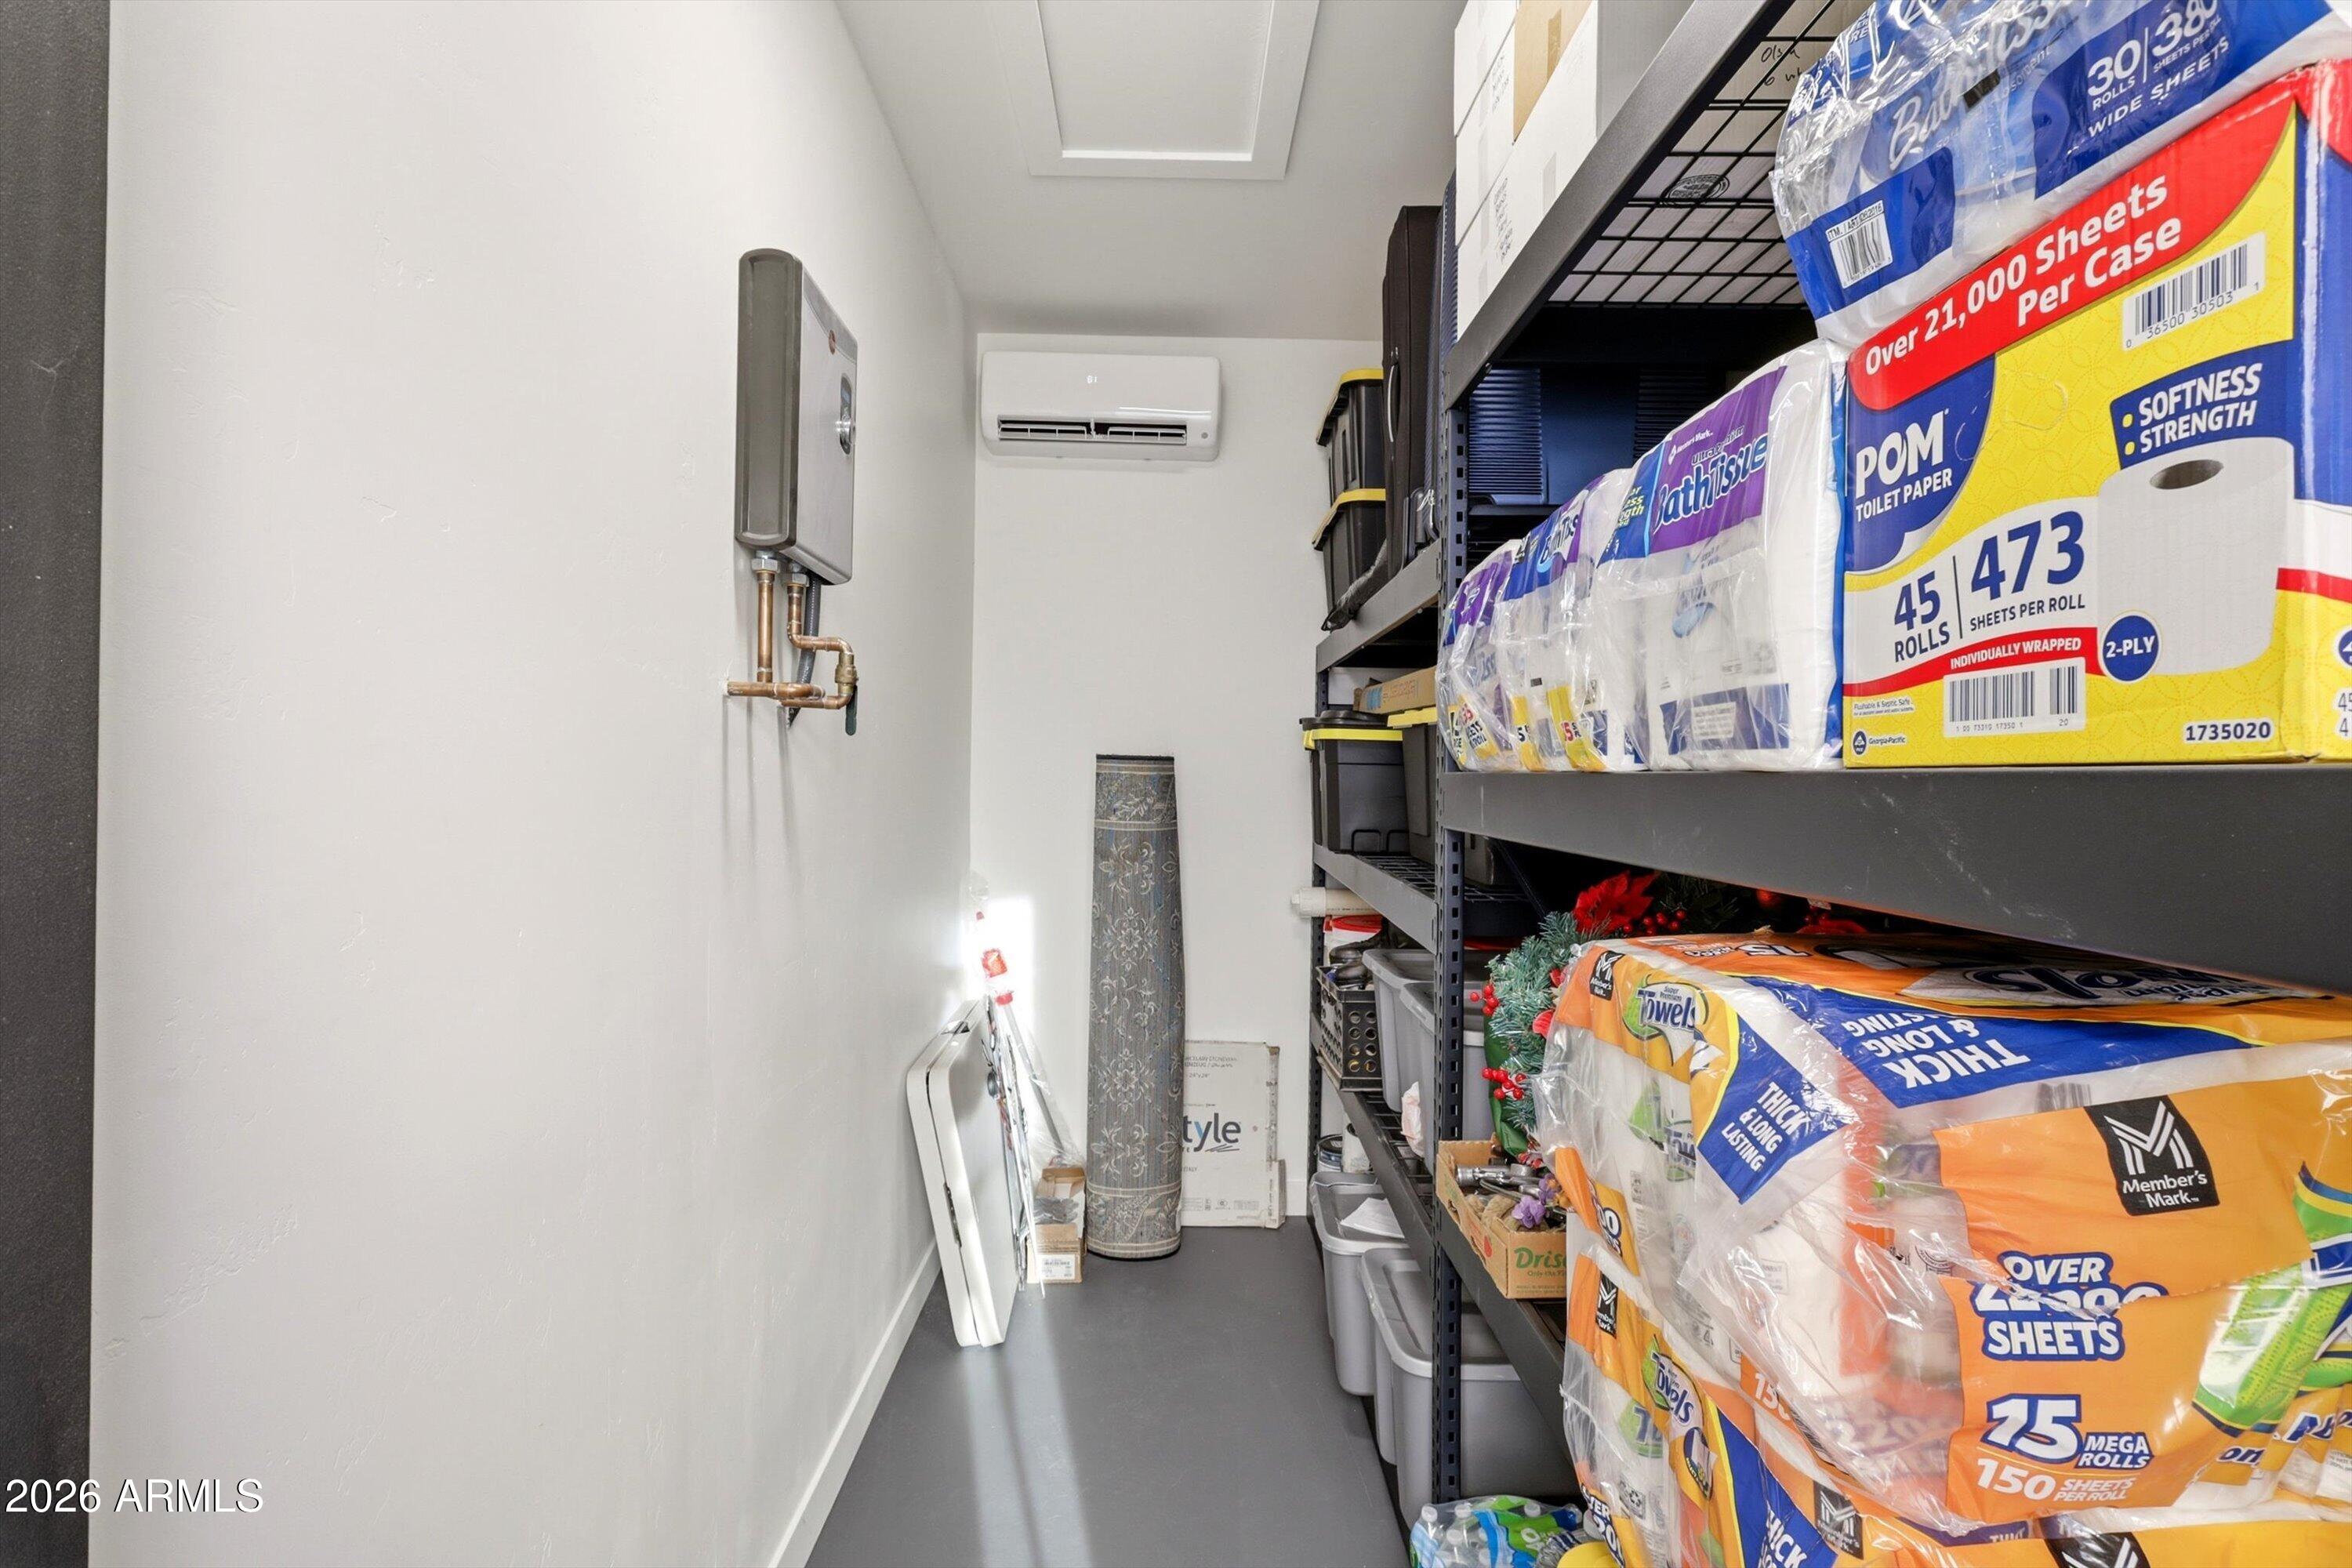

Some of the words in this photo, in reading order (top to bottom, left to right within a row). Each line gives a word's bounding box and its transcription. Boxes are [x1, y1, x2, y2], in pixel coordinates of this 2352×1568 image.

[2088, 40, 2141, 96] 30
[2154, 42, 2191, 73] SHEETS
[2193, 30, 2210, 48] PER
[2089, 95, 2143, 137] WIDE
[2151, 36, 2230, 100] SHEETS
[2092, 76, 2136, 111] ROLLS
[1865, 328, 1918, 376] Over
[1923, 253, 2027, 339] 21,000
[2036, 175, 2168, 275] Sheets
[2017, 284, 2074, 328] Per
[2084, 217, 2181, 289] Case
[2125, 339, 2132, 349] 0
[2147, 313, 2186, 339] 36500
[2191, 291, 2234, 319] 30503
[2253, 281, 2259, 291] 1
[2139, 362, 2263, 426] SOFTNESS
[2140, 400, 2257, 454] STRENGTH
[1856, 414, 1944, 499] POM
[1856, 491, 1900, 523] TOILET
[1904, 468, 1952, 504] PAPER
[1970, 510, 2085, 601] 473
[1894, 570, 1941, 631] 45
[1969, 606, 2016, 632] SHEETS
[2020, 600, 2045, 619] PER
[2049, 593, 2085, 612] ROLL
[1894, 621, 1951, 662] ROLLS
[1951, 642, 2020, 670] INDIVIDUALLY
[2022, 637, 2081, 653] WRAPPED
[2106, 635, 2155, 659] 2-PLY
[2186, 721, 2271, 742] 1735020
[1664, 985, 1679, 994] Super
[1842, 1012, 1939, 1036] STING
[1861, 1025, 1954, 1058] LONG
[1947, 1018, 1980, 1038] &
[1882, 1039, 2031, 1088] THICK
[1739, 1107, 1757, 1124] &
[1757, 1081, 1811, 1135] THICK
[1182, 1112, 1241, 1152] tyle
[1722, 1122, 1766, 1171] LASTING
[1747, 1114, 1783, 1154] LONG
[2122, 1171, 2208, 1196] Member's
[2146, 1191, 2191, 1209] Mark
[2004, 1256, 2105, 1285] OVER
[1987, 1320, 2119, 1355] SHEETS
[1987, 1399, 2078, 1459] 15
[2085, 1436, 2150, 1454] MEGA
[1977, 1458, 2056, 1500] 150
[2060, 1477, 2136, 1490] SHEETS
[2078, 1453, 2150, 1468] ROLLS
[2053, 1490, 2086, 1501] PER
[2088, 1489, 2126, 1501] ROLL
